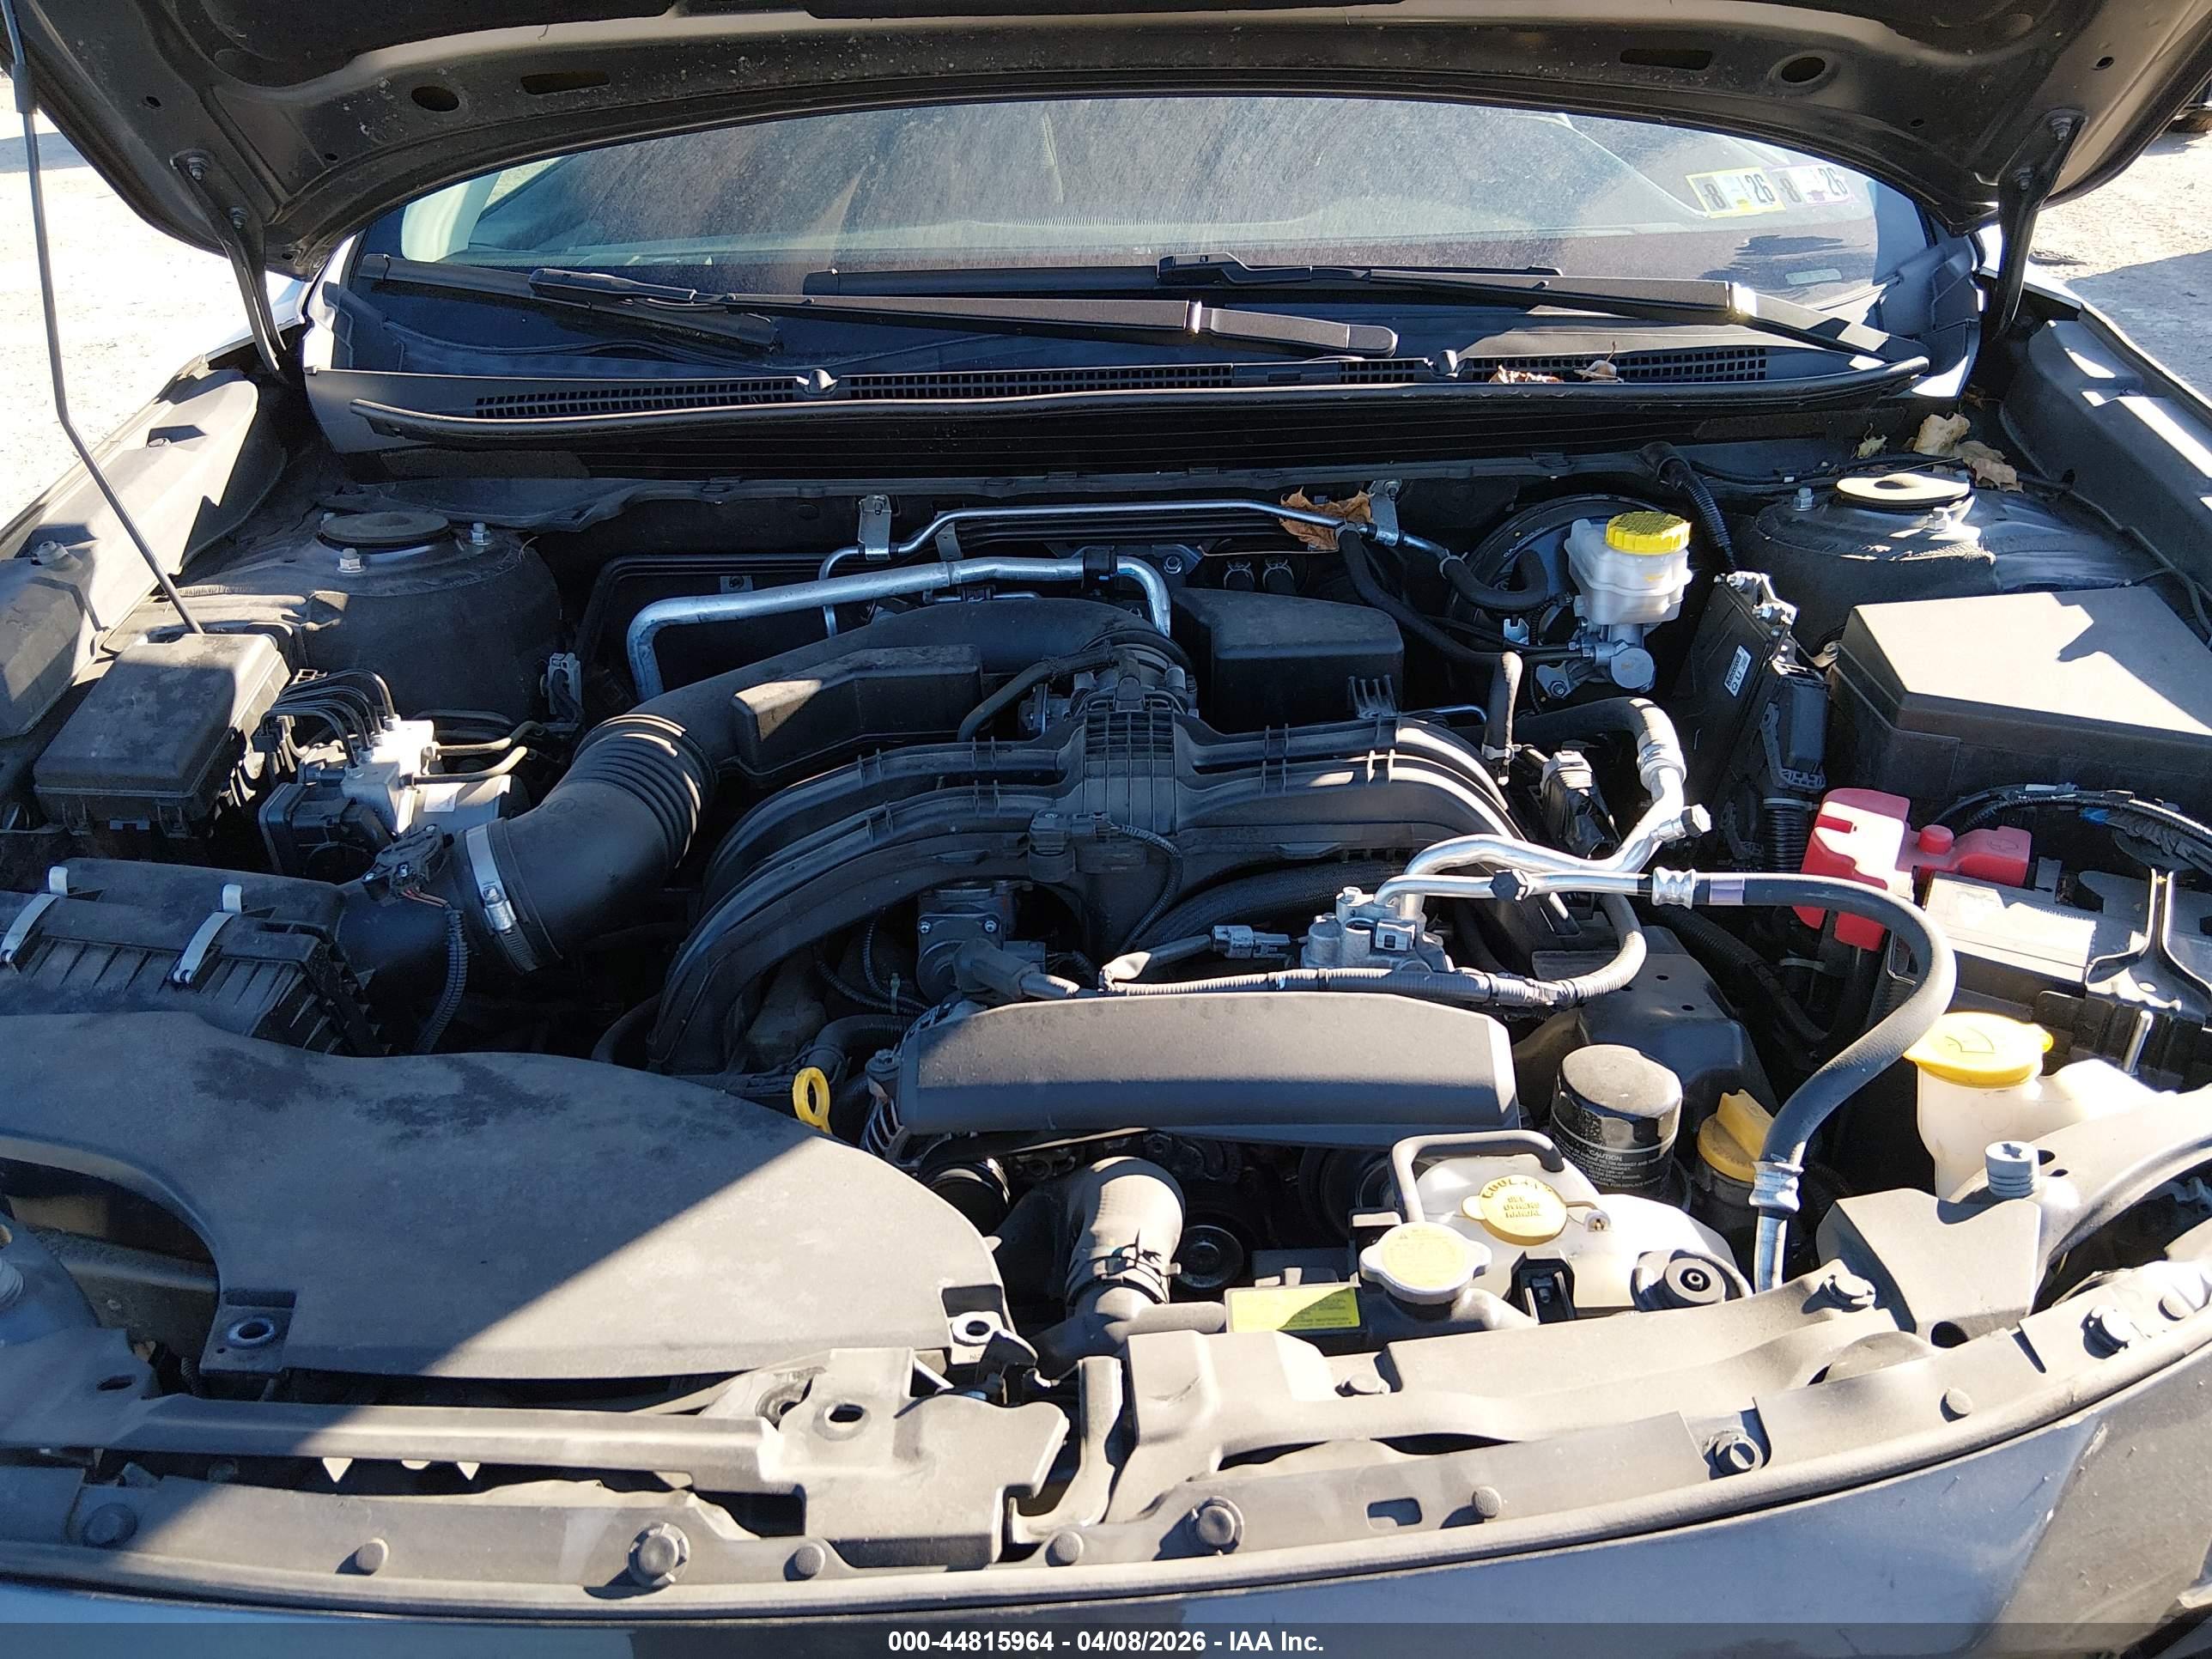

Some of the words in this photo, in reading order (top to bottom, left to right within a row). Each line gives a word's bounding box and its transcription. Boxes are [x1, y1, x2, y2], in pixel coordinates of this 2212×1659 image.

[1744, 173, 1776, 204] 26
[1818, 167, 1849, 196] 26
[1589, 1150, 1623, 1162] CAUTION
